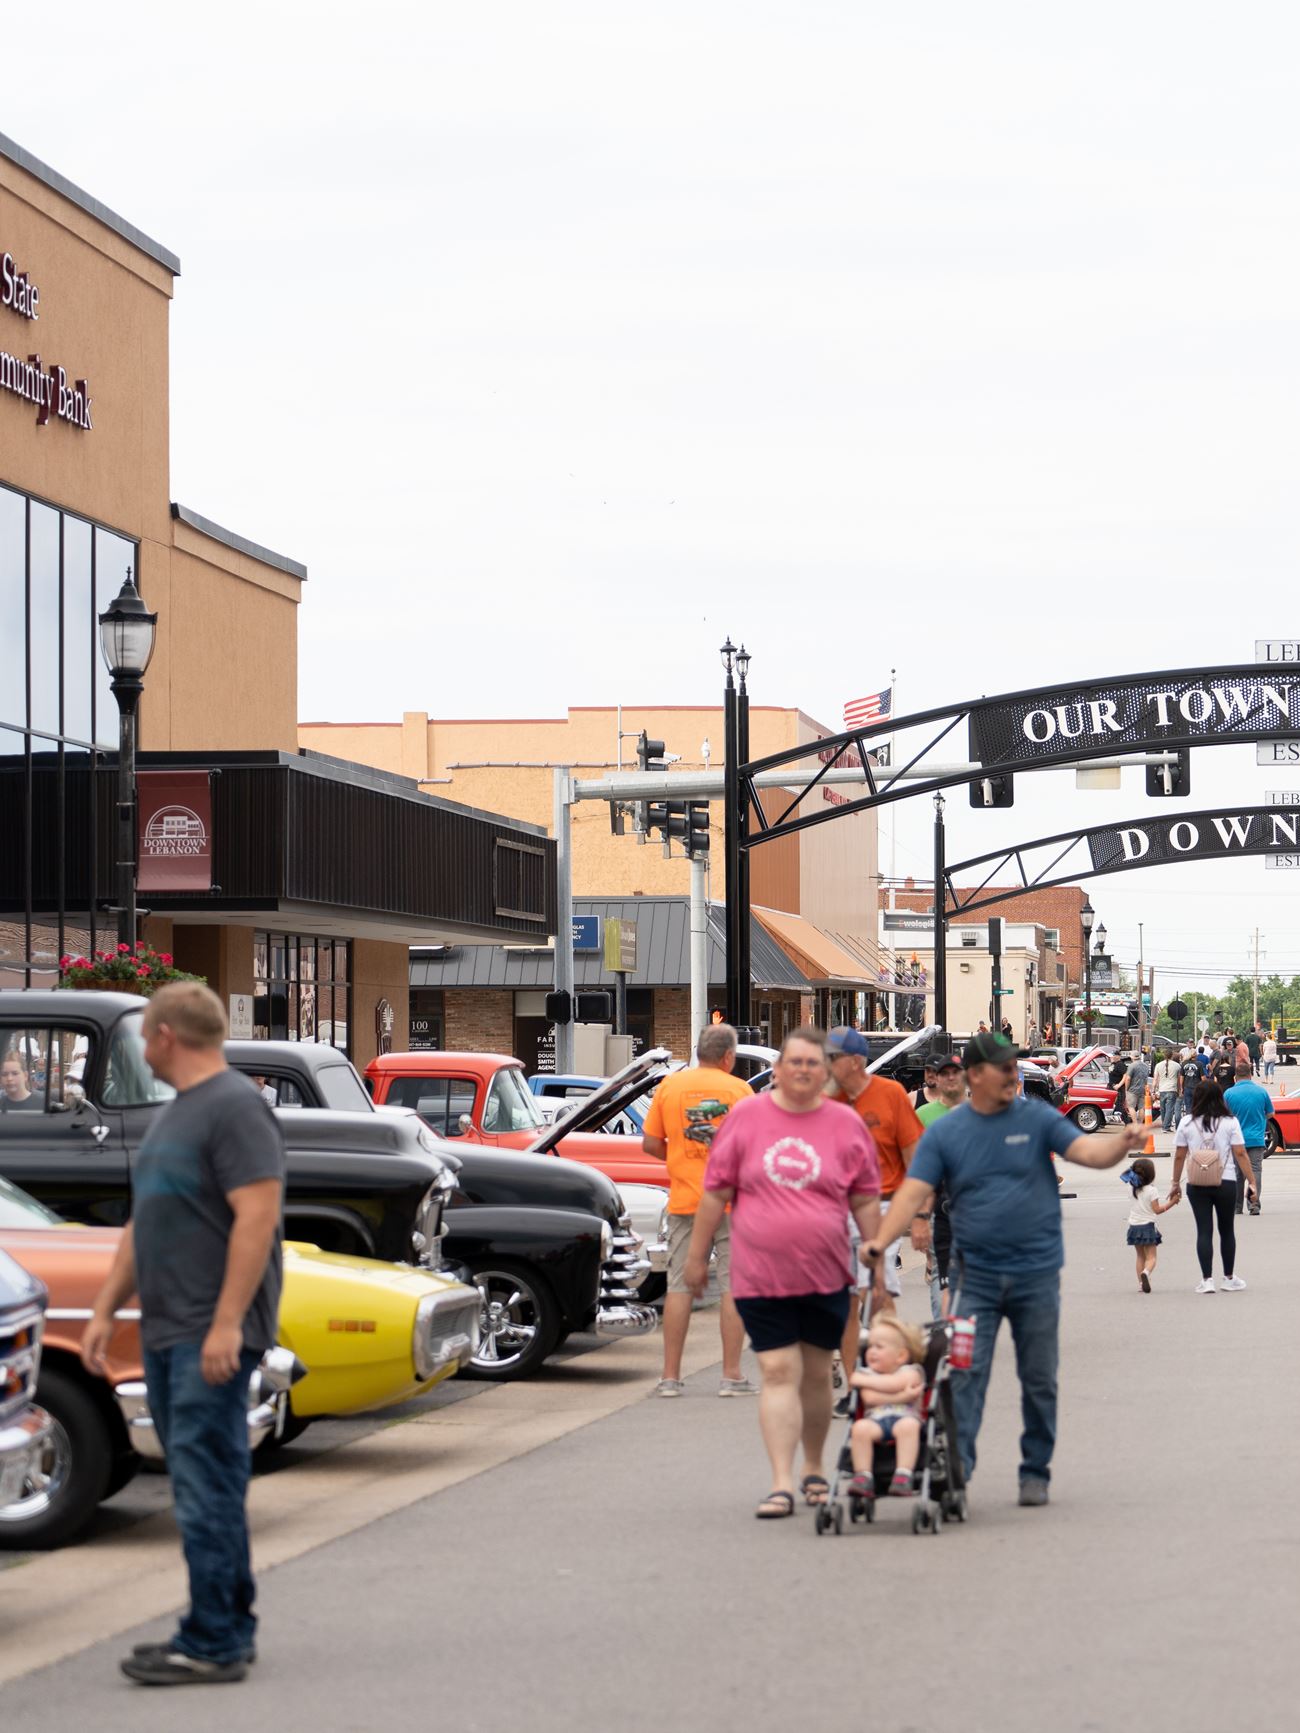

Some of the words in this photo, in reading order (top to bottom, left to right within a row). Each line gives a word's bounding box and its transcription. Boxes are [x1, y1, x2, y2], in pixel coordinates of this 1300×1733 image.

[2, 252, 40, 321] State
[57, 365, 93, 430] Bank
[1022, 699, 1124, 744] OUR
[1147, 684, 1293, 727] TOWN
[144, 838, 207, 848] DOWNTOWN
[150, 846, 200, 855] LEBANON
[411, 1020, 428, 1030] 100
